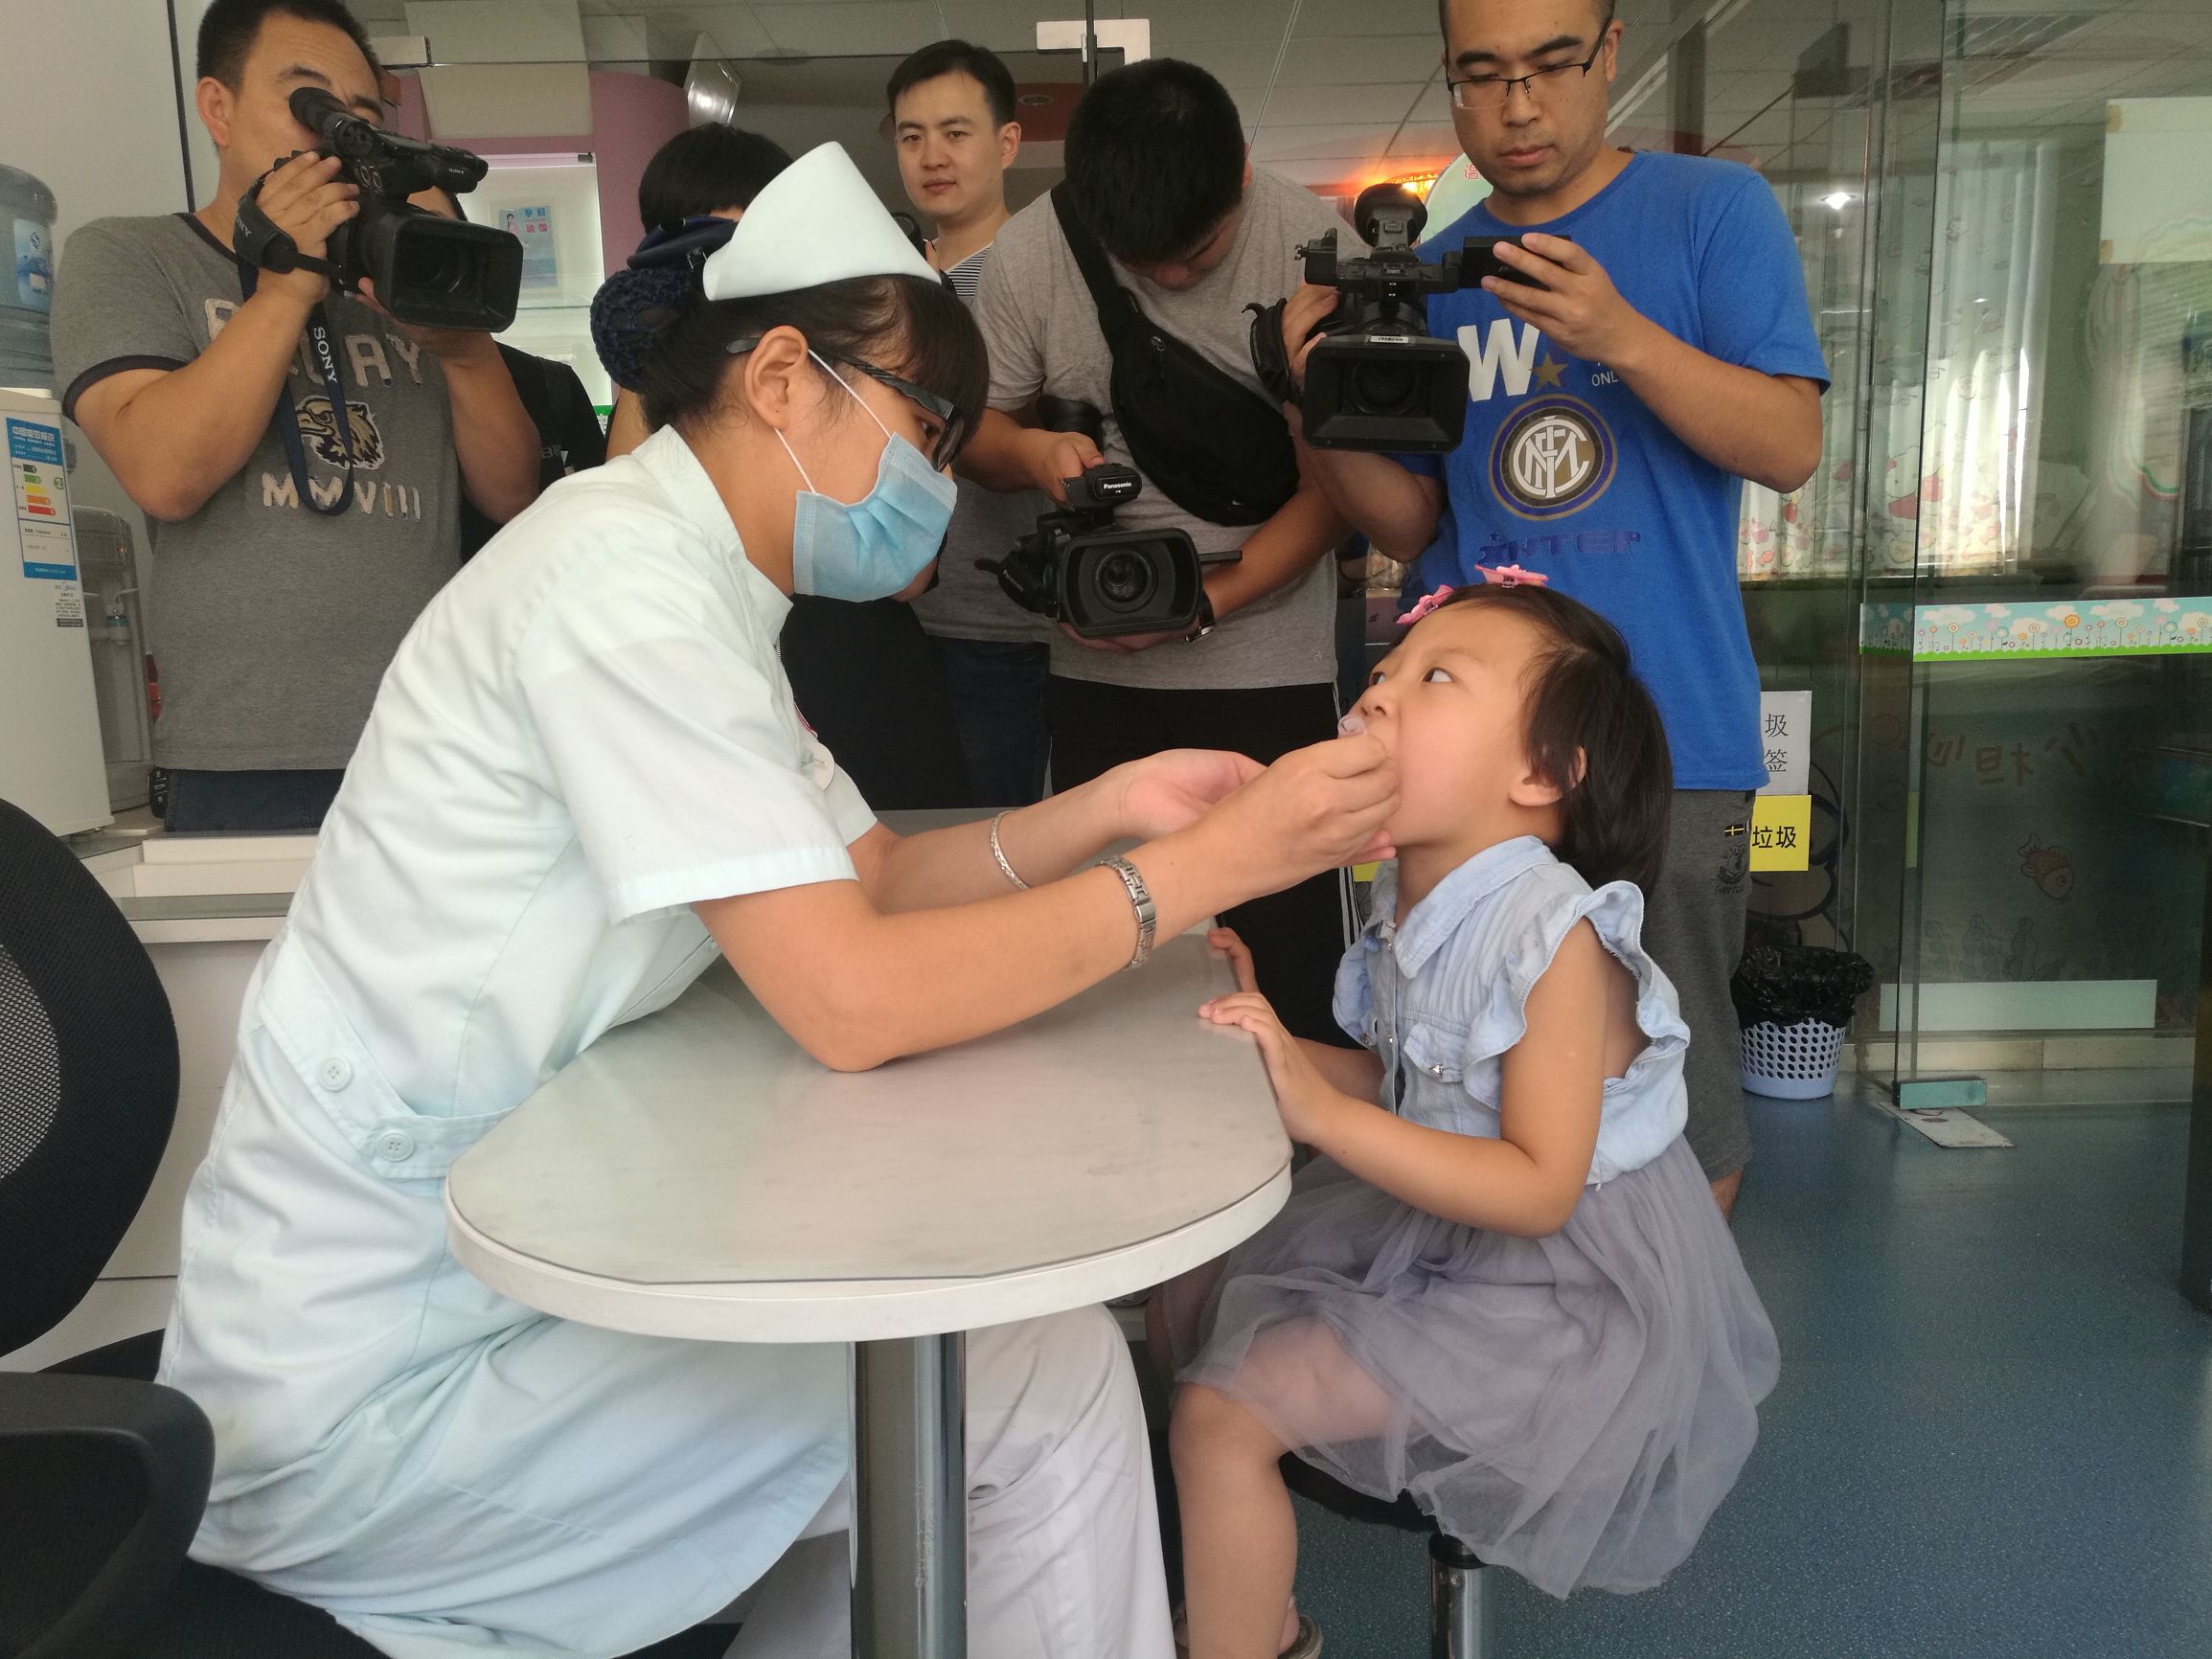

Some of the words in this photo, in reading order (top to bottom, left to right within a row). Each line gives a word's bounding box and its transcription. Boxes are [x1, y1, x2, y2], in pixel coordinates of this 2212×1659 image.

[313, 326, 338, 383] SONY
[1591, 370, 1619, 388] ONL
[1103, 481, 1132, 489] Panasonic
[1751, 825, 1797, 850] 垃圾
